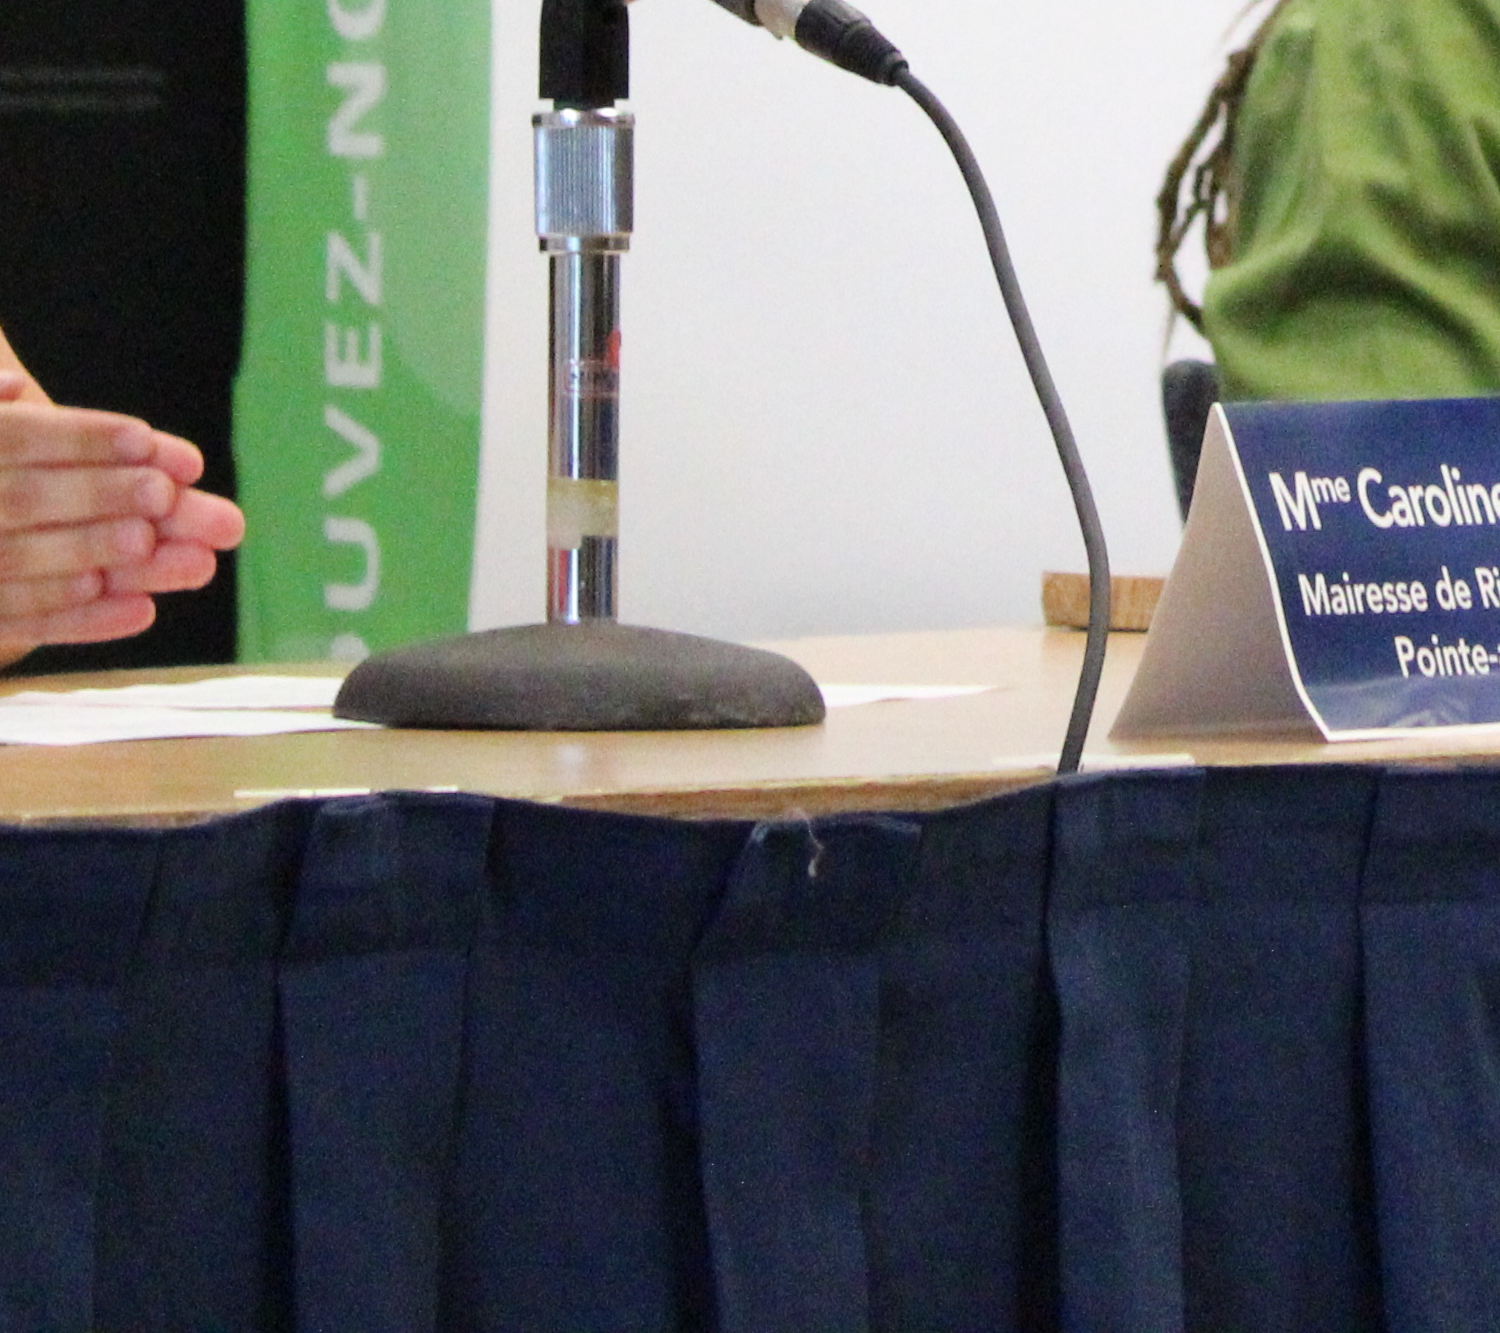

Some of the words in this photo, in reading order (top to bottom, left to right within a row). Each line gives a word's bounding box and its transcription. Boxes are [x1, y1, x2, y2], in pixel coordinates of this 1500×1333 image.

[1269, 471, 1351, 532] Mme
[1298, 571, 1428, 617] Mairesse
[1435, 565, 1473, 611] de
